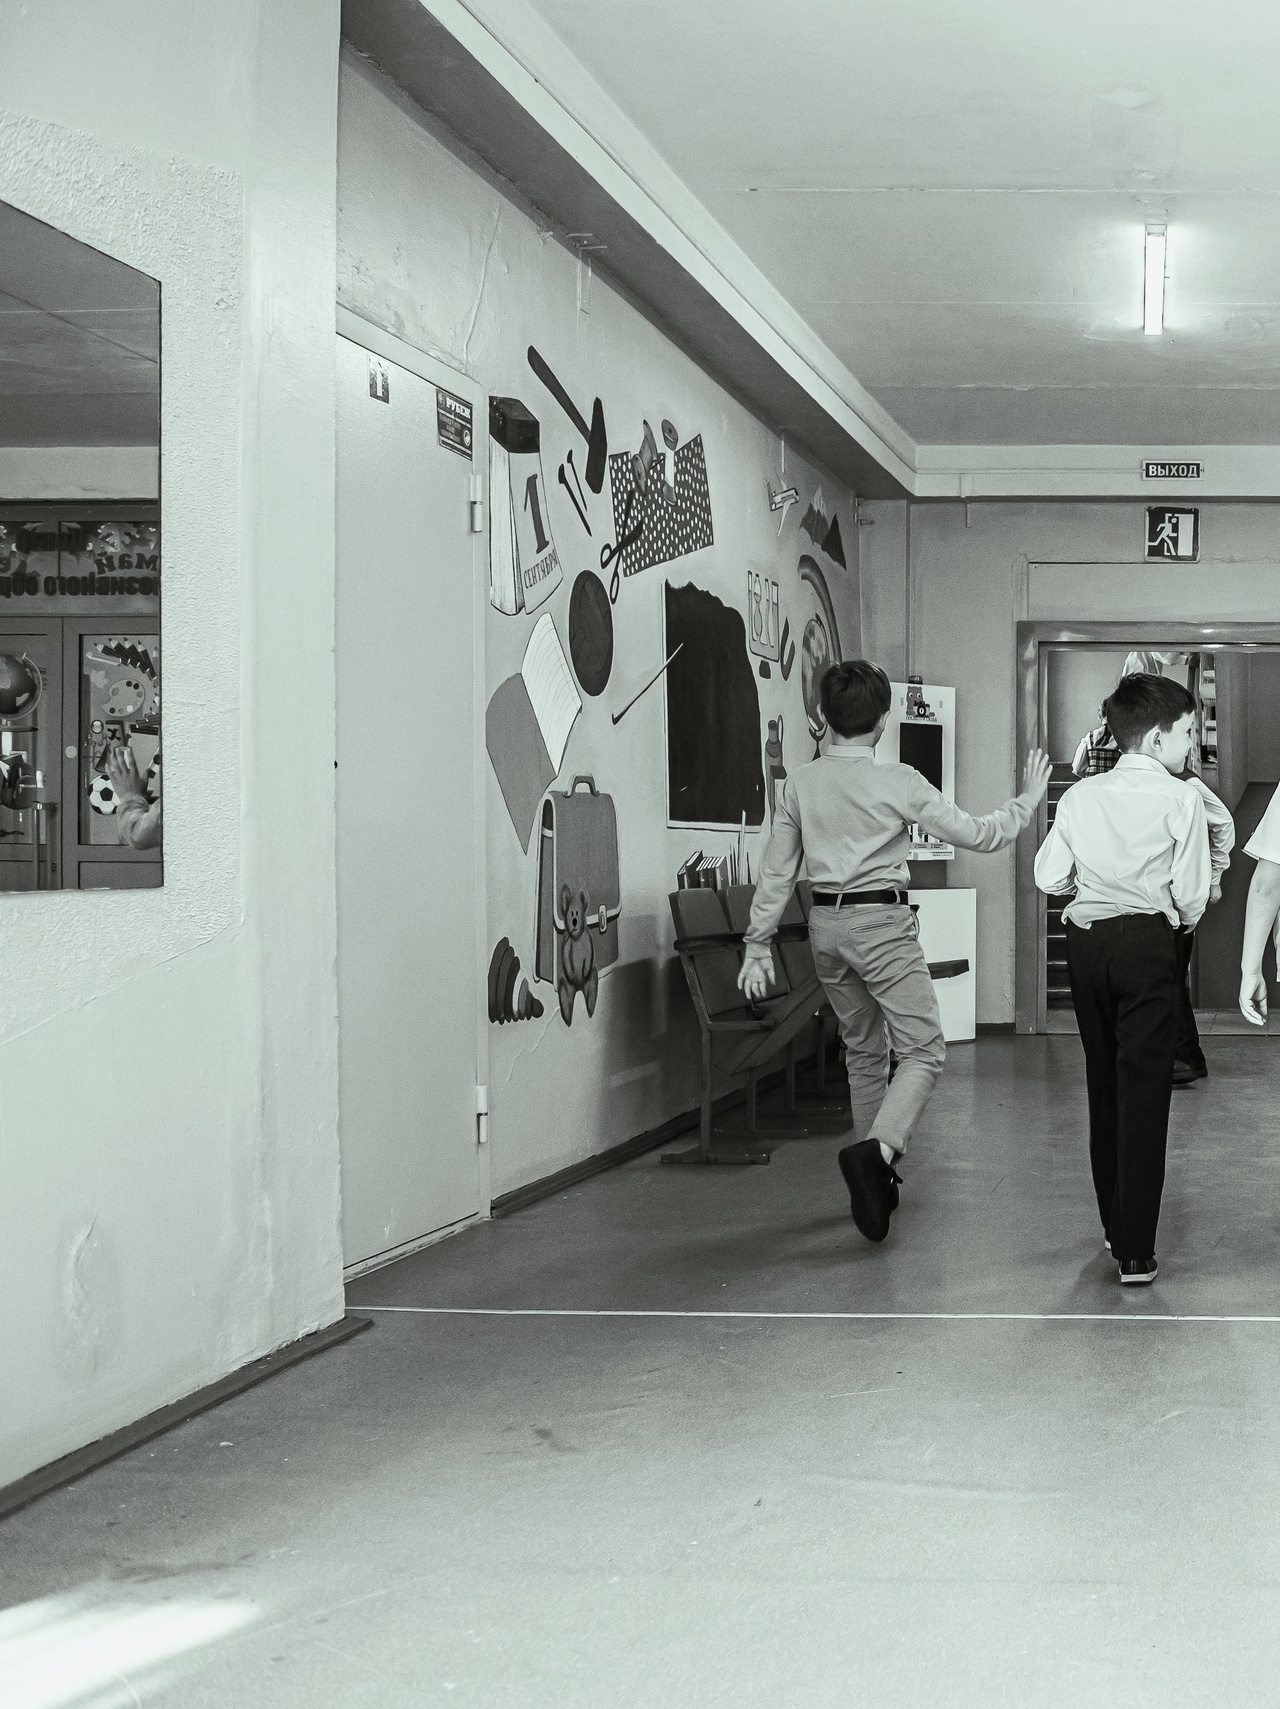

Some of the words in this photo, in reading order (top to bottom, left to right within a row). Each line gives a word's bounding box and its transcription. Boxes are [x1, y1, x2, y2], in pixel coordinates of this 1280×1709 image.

[1149, 465, 1198, 478] ВЫХОД
[524, 473, 550, 554] 1
[523, 547, 559, 590] СЕНТЯБРЯ
